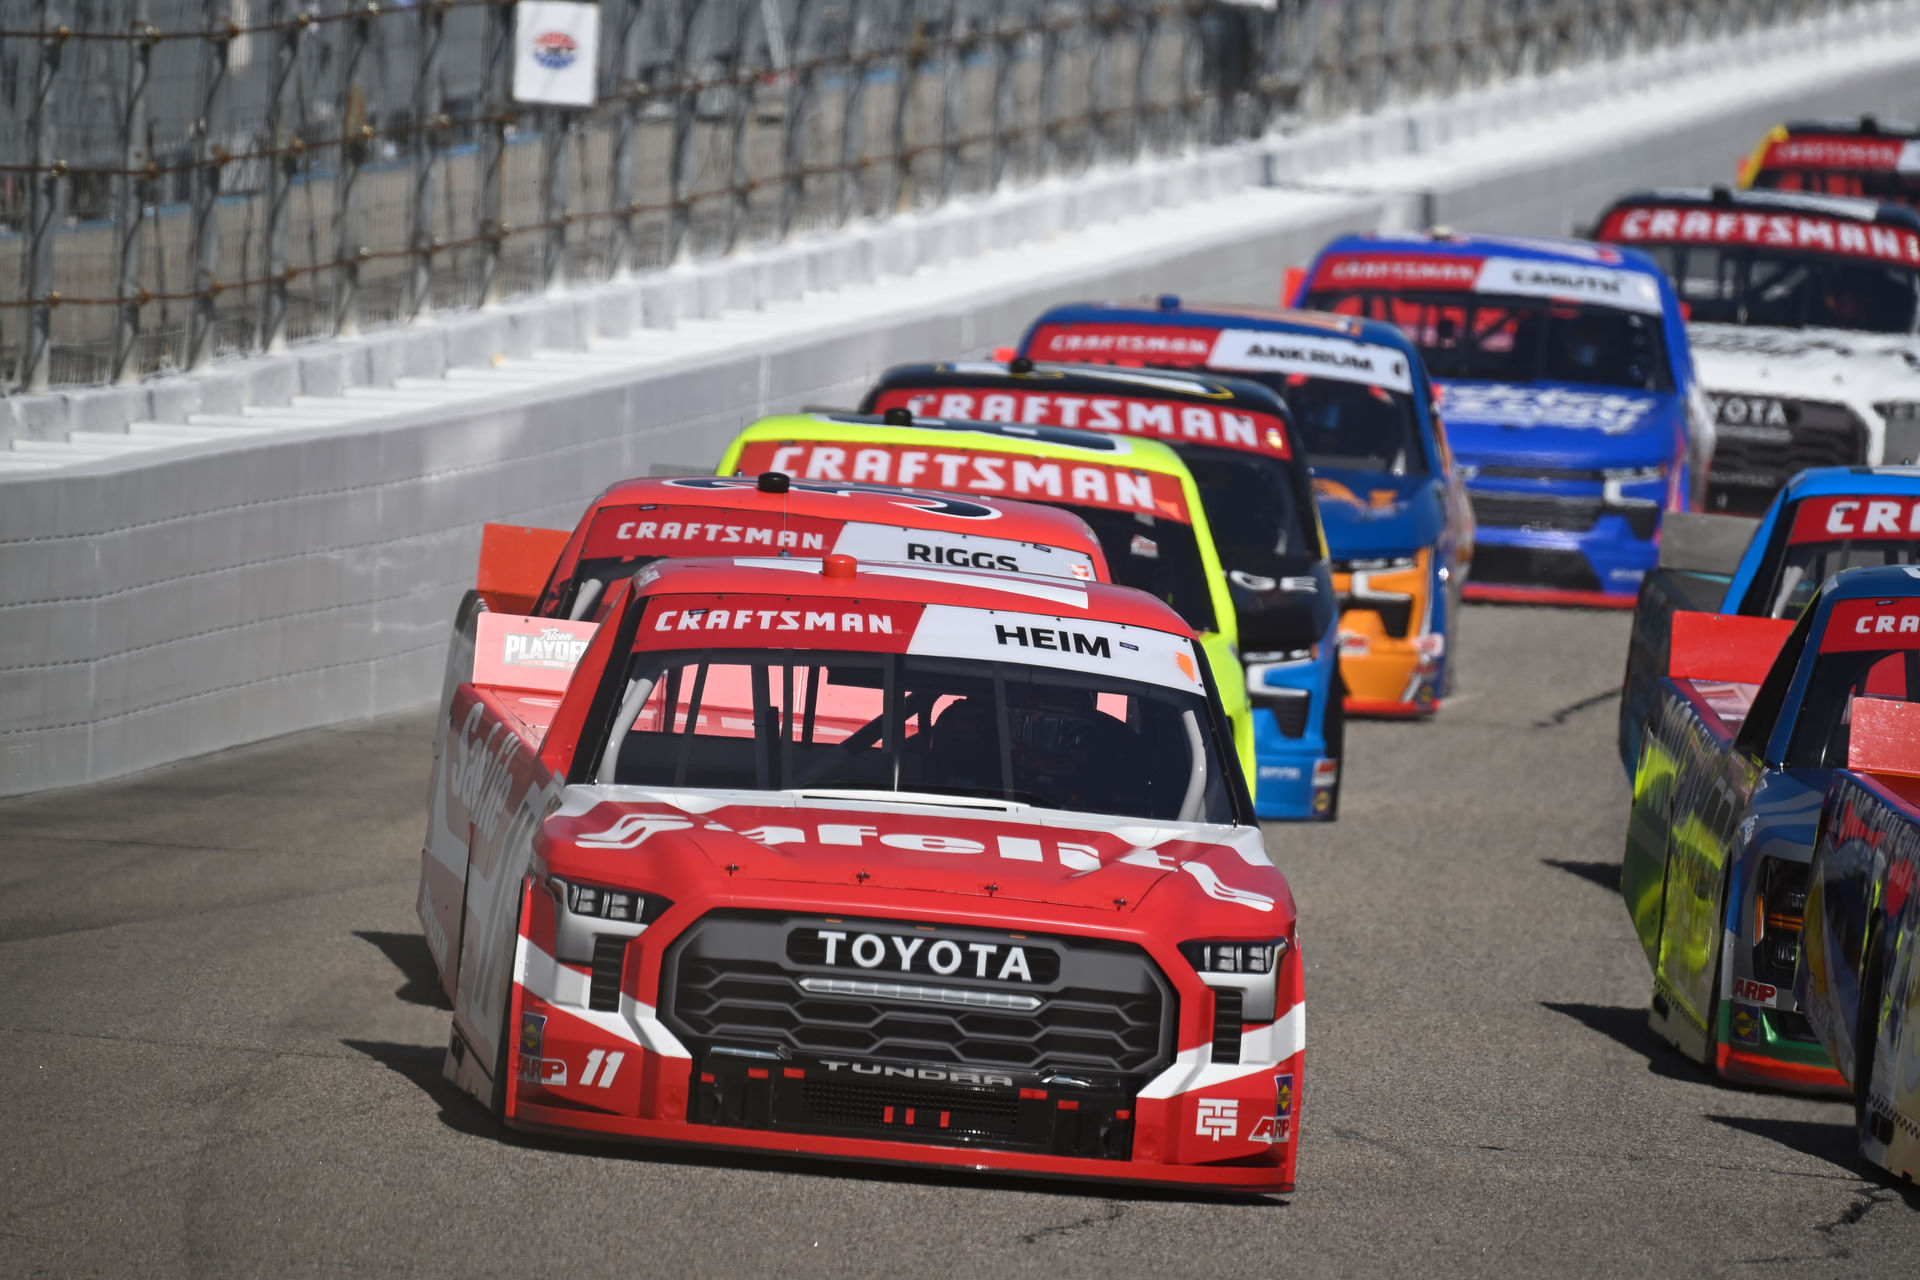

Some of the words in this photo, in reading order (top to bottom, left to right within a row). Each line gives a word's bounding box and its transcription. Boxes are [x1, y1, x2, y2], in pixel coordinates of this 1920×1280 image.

[1620, 207, 1900, 259] CRAFTSMAN
[1332, 261, 1475, 281] CRAFTSMAN
[1050, 334, 1208, 355] CRAFTSMAN
[907, 393, 1258, 448] CRAFTSMAN
[770, 446, 1155, 509] CRAFTSMAN
[616, 521, 823, 550] CRAFTSMAN
[907, 543, 1019, 572] RIGGS
[654, 609, 893, 634] CRAFTSMAN
[995, 624, 1111, 660] HEIM
[818, 930, 1032, 983] TOYOTA
[1734, 978, 1776, 1002] ARP
[579, 1048, 625, 1088] 11
[819, 1060, 1013, 1087] TUNDRA
